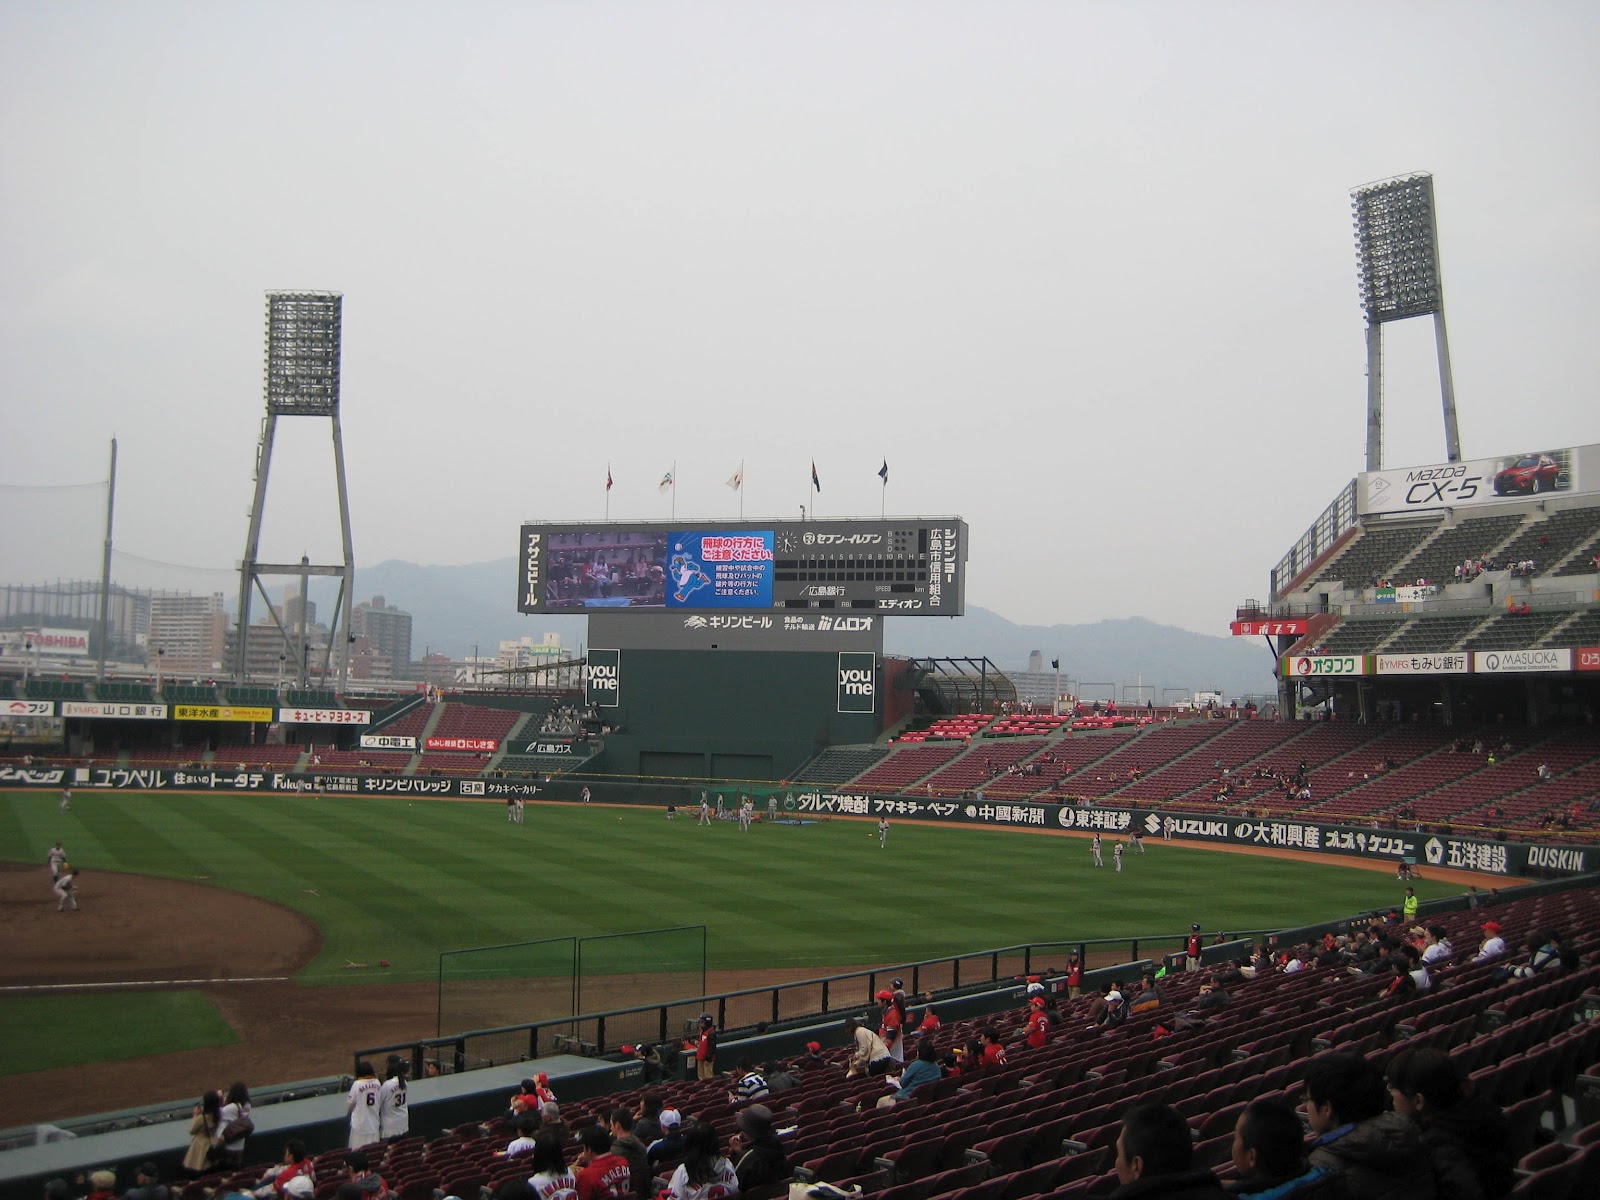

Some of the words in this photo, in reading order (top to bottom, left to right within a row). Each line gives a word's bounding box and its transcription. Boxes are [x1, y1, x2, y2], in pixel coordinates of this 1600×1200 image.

[1405, 476, 1482, 504] CX-5
[702, 537, 764, 549] 飛球の行方に
[944, 528, 956, 583] シシンヨー
[525, 534, 541, 606] アサヒビール
[929, 528, 942, 606] 広島市信用組合
[808, 586, 846, 597] 広島銀行
[879, 600, 922, 609] エディオン
[709, 616, 773, 629] キリンビール
[833, 616, 873, 631] ムロオ
[1259, 622, 1297, 635] ポプラ
[24, 634, 86, 648] TOSHIBA
[1312, 658, 1354, 673] オタフク
[1384, 660, 1409, 669] YMFG
[1411, 656, 1464, 670] もみじ銀行
[1502, 652, 1558, 665] MASUOKA
[588, 665, 616, 679] you
[840, 669, 871, 685] you
[593, 677, 618, 690] me
[845, 682, 873, 695] me
[28, 703, 49, 714] フジ
[73, 706, 99, 715] YMFG
[103, 705, 163, 716] 山口銀行
[178, 708, 220, 718] 東洋水産
[378, 737, 411, 748] 中電工
[466, 740, 496, 750] にしき堂
[537, 744, 572, 754] 広島ガス
[95, 769, 167, 788] ユウベル
[174, 772, 264, 788] 住まいのトータテ
[274, 774, 312, 790] Fukua
[365, 778, 451, 792] キリンビバレッジ
[488, 784, 542, 795] タカキベーカリー
[797, 793, 869, 814] ダルマ焼酎
[874, 799, 924, 814] フマキラー
[927, 802, 960, 816] ベープ
[1075, 809, 1132, 830] 東洋証券
[1165, 816, 1228, 837] SUZUKI
[1254, 821, 1320, 848] 大和興産
[1325, 830, 1355, 850] プルプル
[1368, 834, 1414, 855] ケンユー
[1447, 840, 1507, 873] 五洋建設
[1528, 846, 1584, 871] DUSKIN
[367, 1092, 375, 1106] 6
[395, 1092, 406, 1107] 31
[601, 1165, 631, 1186] MAEDA
